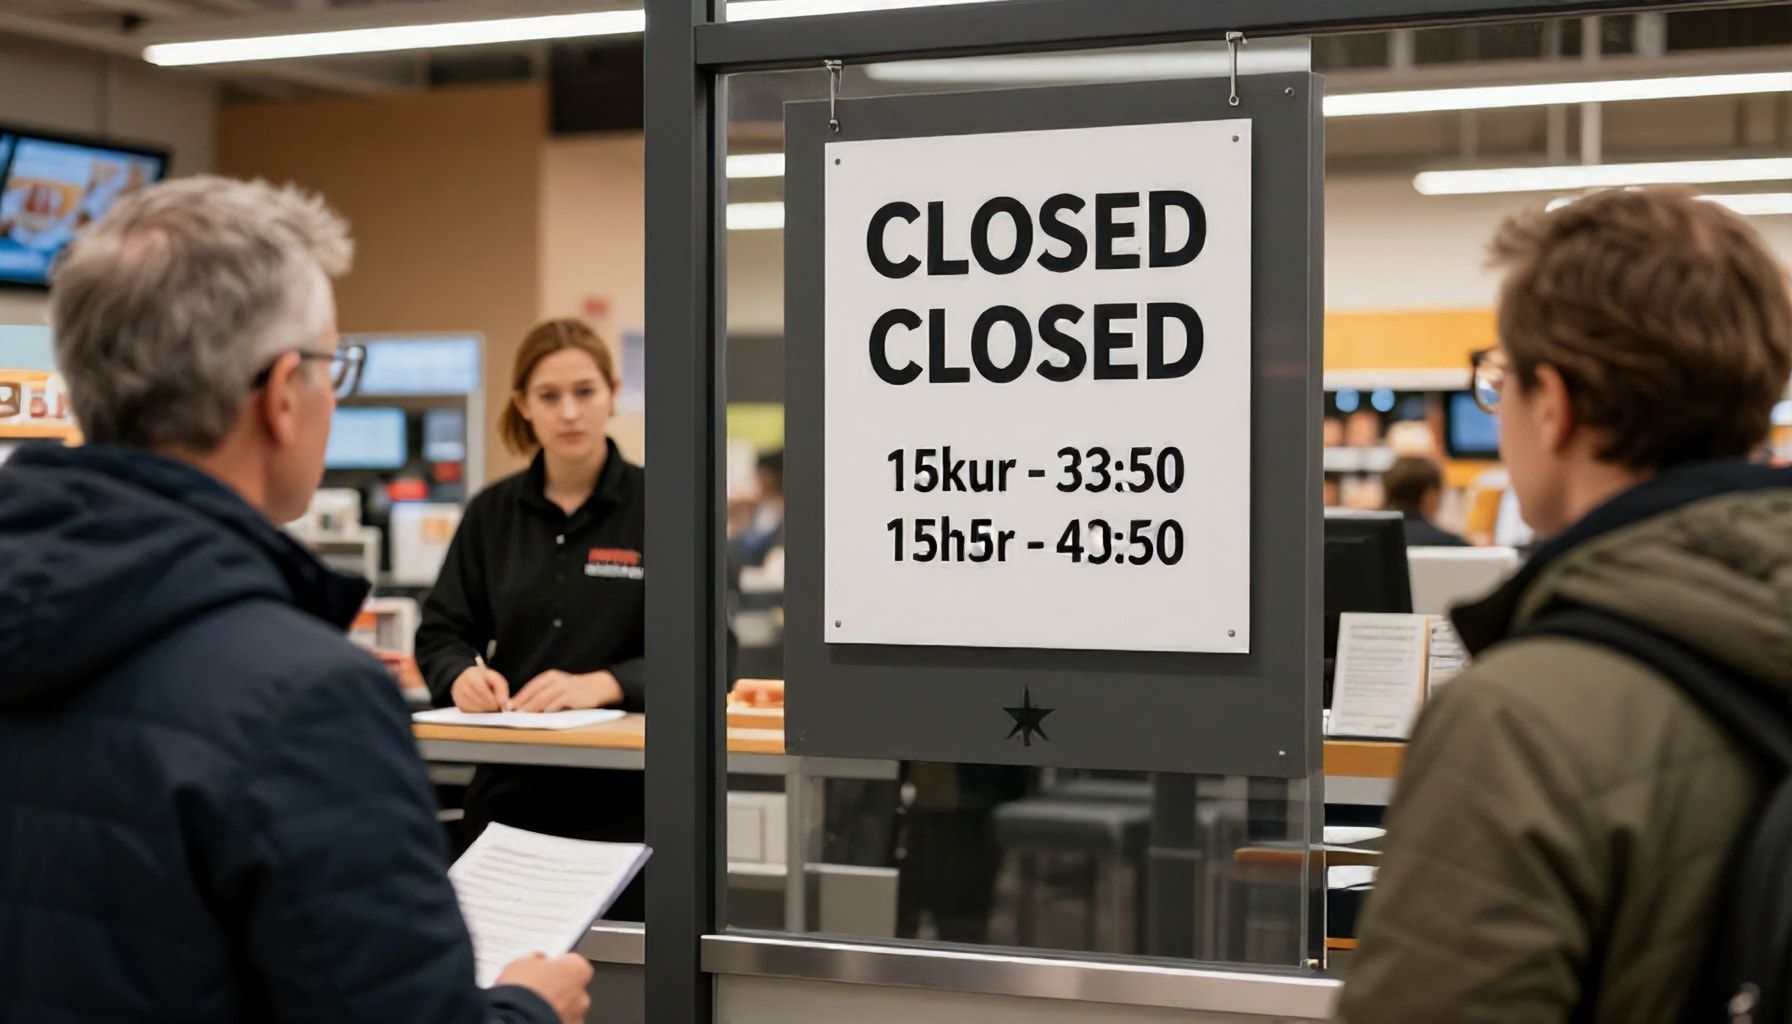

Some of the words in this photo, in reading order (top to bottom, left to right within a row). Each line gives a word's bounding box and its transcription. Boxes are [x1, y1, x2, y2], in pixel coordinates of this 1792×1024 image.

[866, 190, 1207, 280] CLOSED
[868, 302, 1204, 386] CLOSED
[887, 445, 1017, 493] 15kur
[1056, 446, 1185, 494] 33:50
[886, 515, 1016, 563] 15h5r
